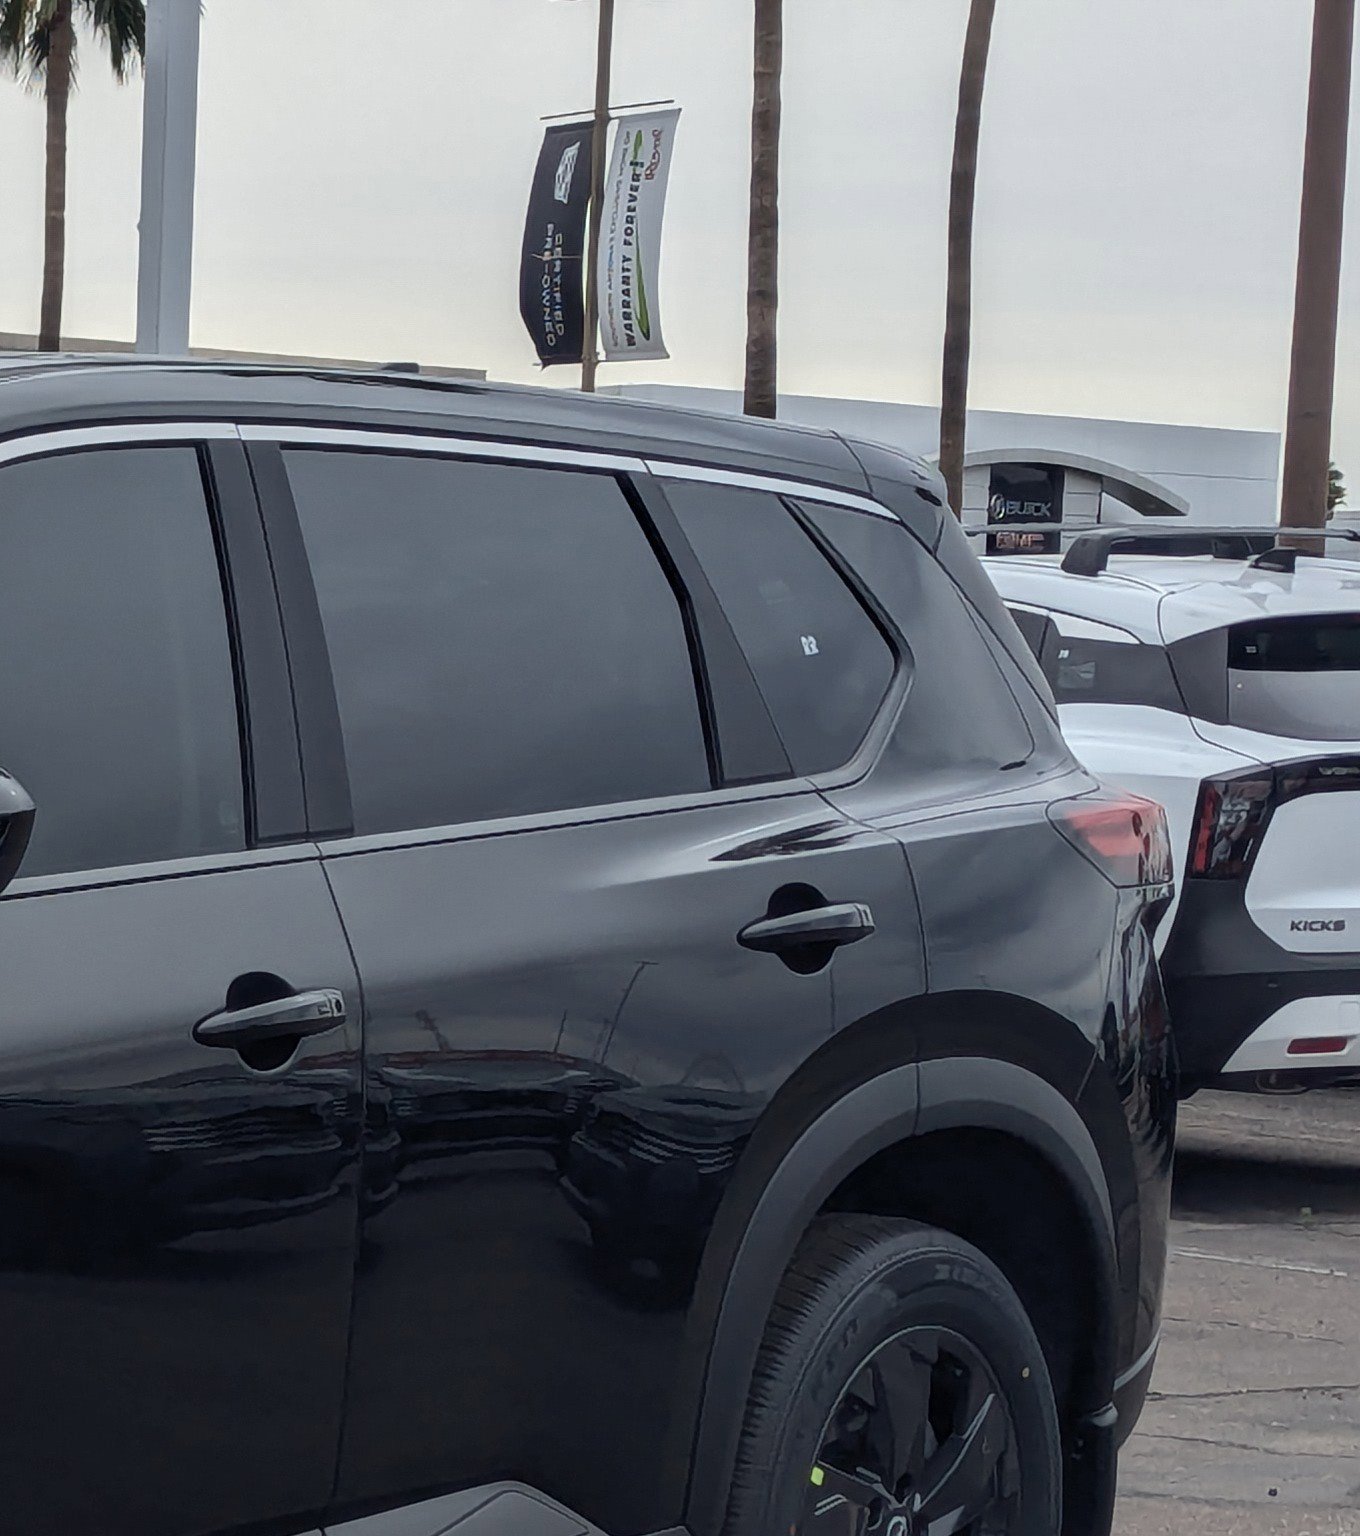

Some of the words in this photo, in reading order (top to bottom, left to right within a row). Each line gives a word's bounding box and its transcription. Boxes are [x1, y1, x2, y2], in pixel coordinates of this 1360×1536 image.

[621, 255, 637, 347] WARRANTY
[1006, 500, 1052, 517] BUICK
[1290, 920, 1346, 932] KICKS
